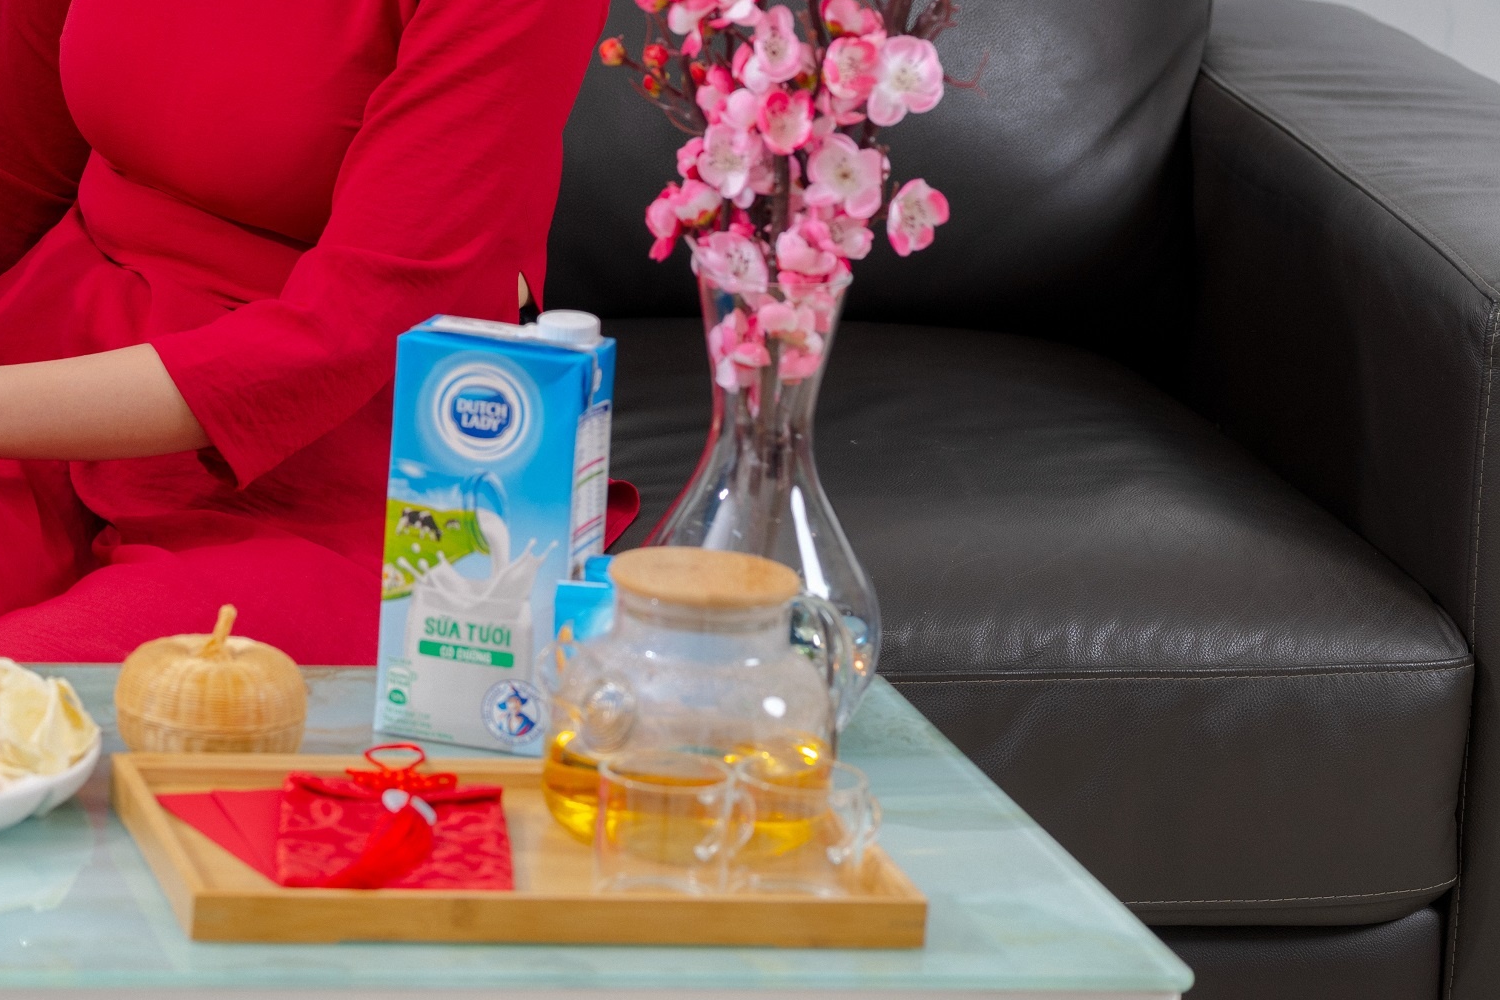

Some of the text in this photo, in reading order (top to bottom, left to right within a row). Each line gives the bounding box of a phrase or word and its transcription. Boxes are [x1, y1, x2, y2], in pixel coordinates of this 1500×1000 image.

[456, 397, 508, 419] DUTCH
[461, 412, 502, 432] LADY
[425, 614, 511, 647] SỮA TƯƠI
